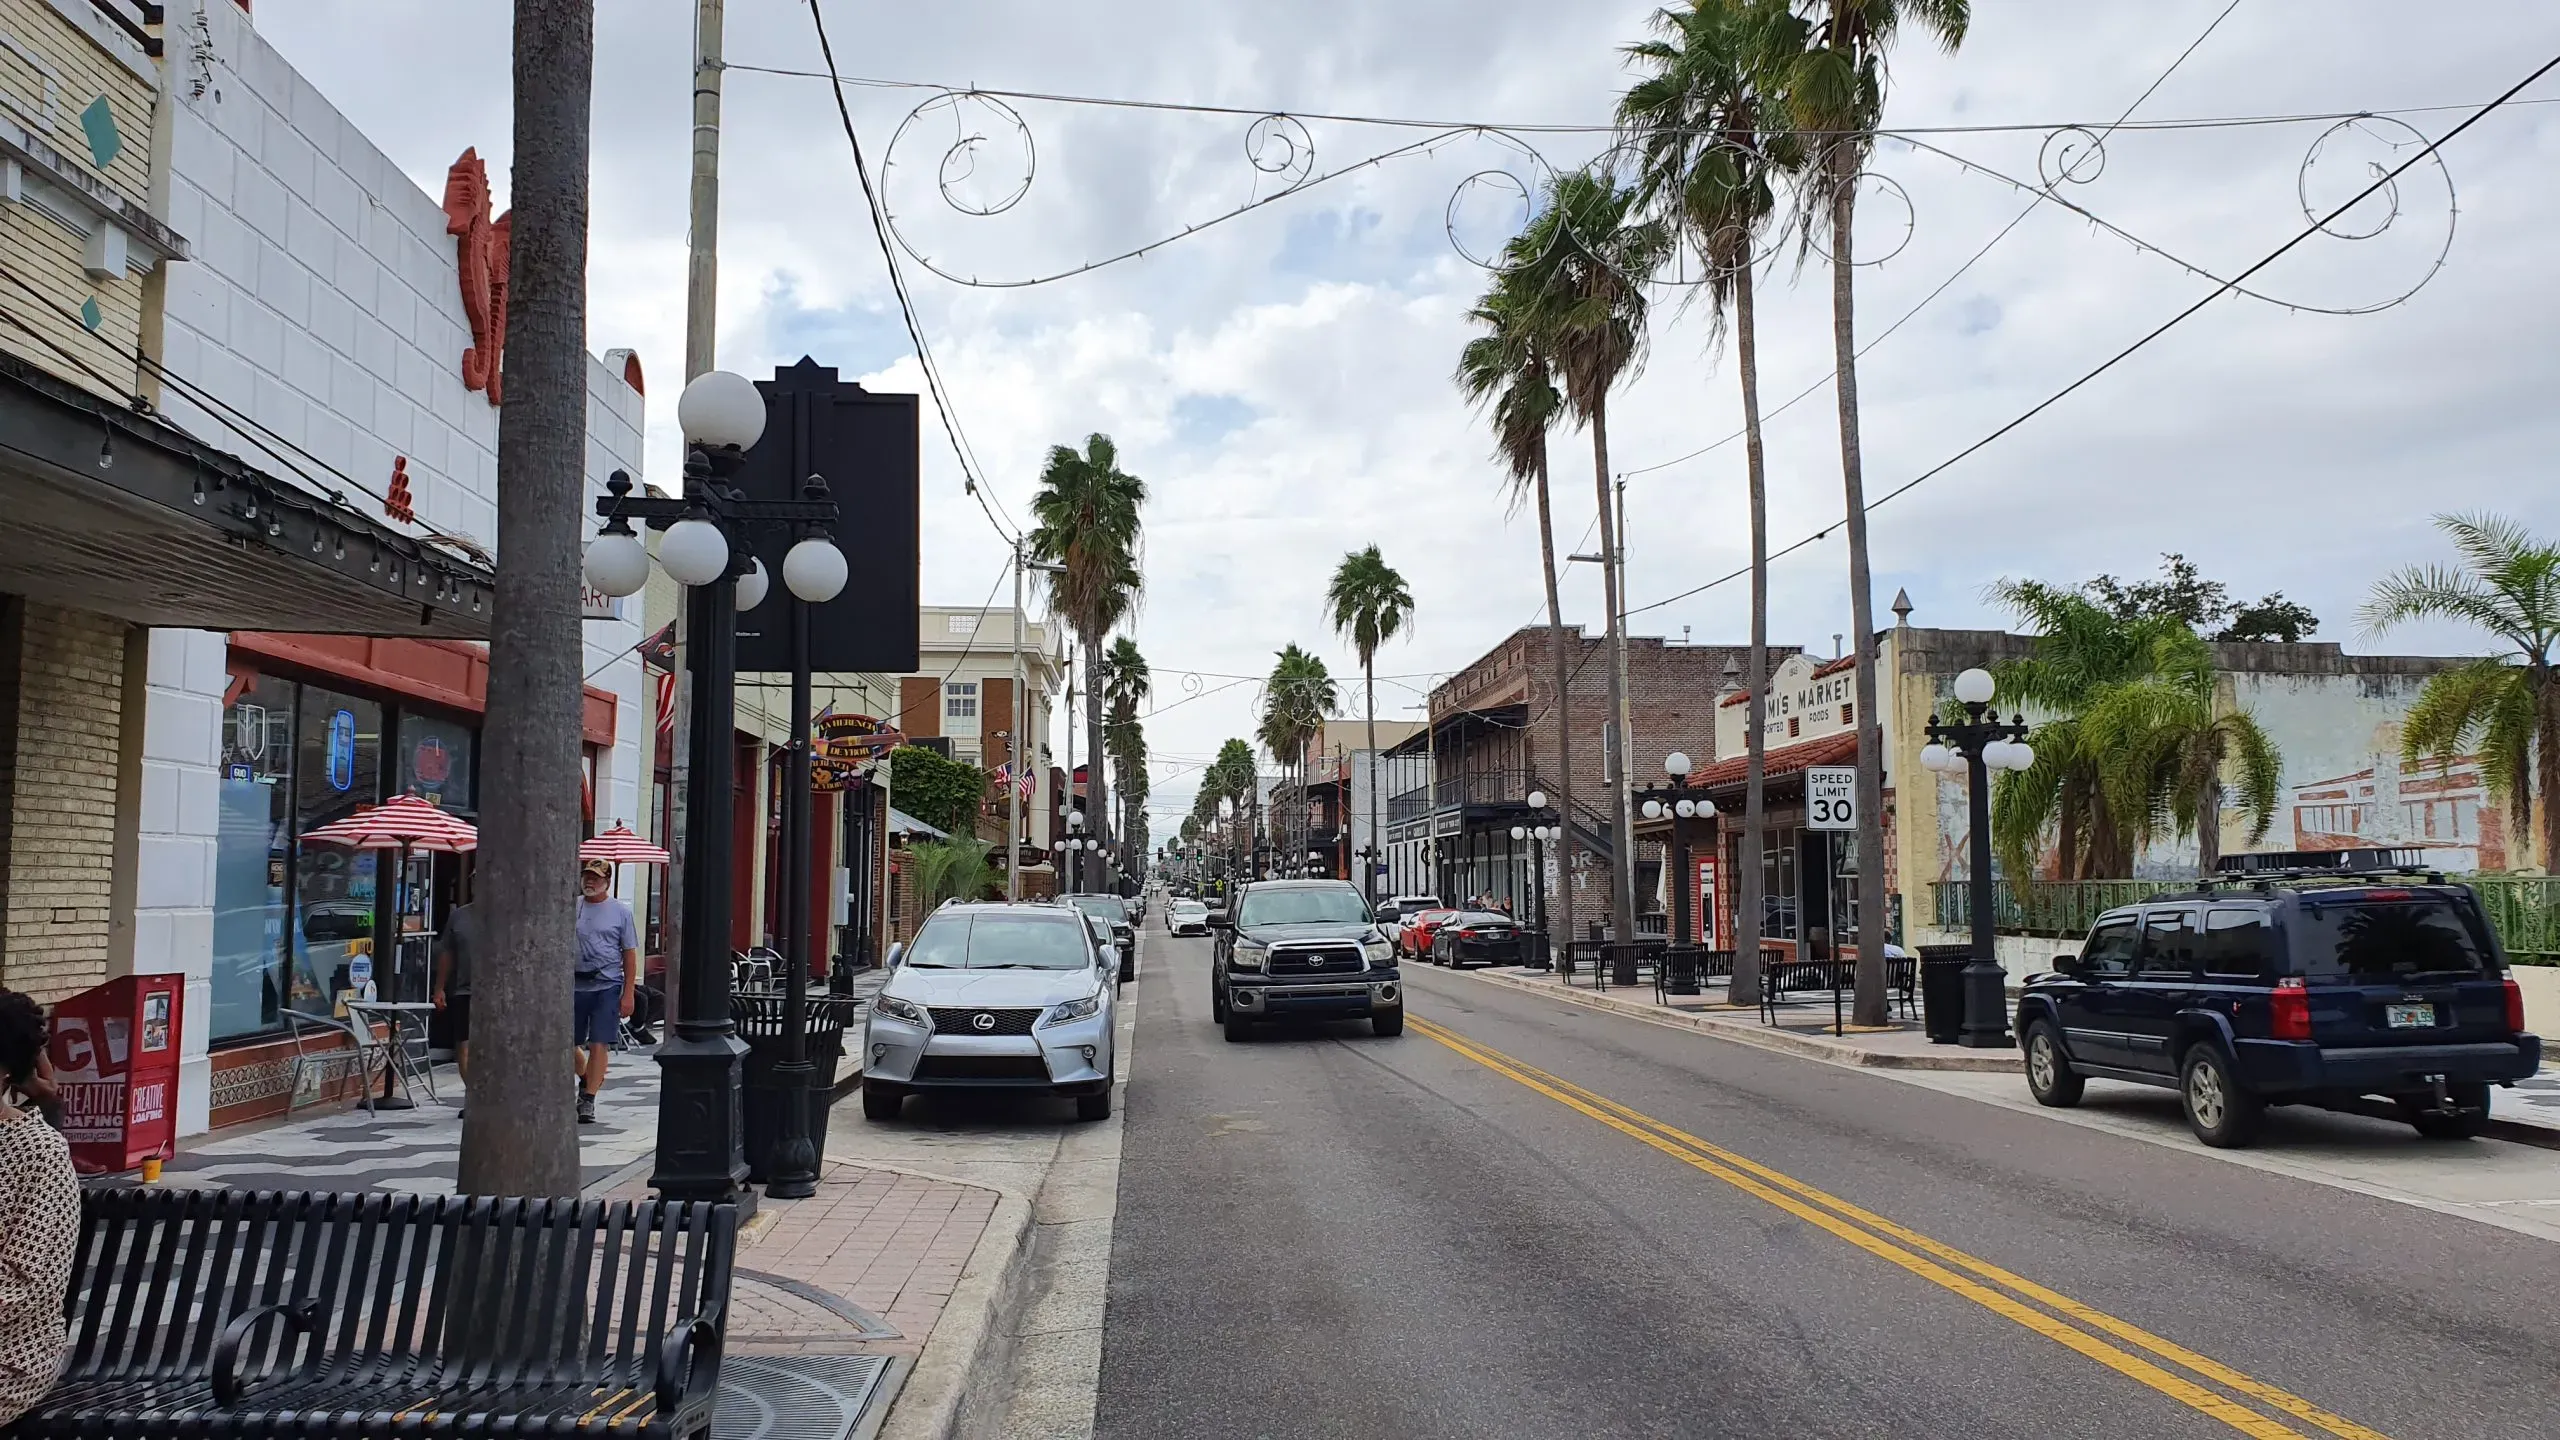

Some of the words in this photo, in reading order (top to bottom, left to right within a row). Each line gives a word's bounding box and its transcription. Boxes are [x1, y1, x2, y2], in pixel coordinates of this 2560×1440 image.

[1798, 677, 1851, 711] MARKET
[1809, 708, 1830, 723] FOODS
[1811, 774, 1853, 785] SPEED
[1815, 786, 1848, 798] LIMIT
[1813, 799, 1853, 823] 30
[132, 1083, 165, 1113] CREATIVE
[62, 1115, 124, 1128] OAFING
[131, 1109, 163, 1124] LOAFING
